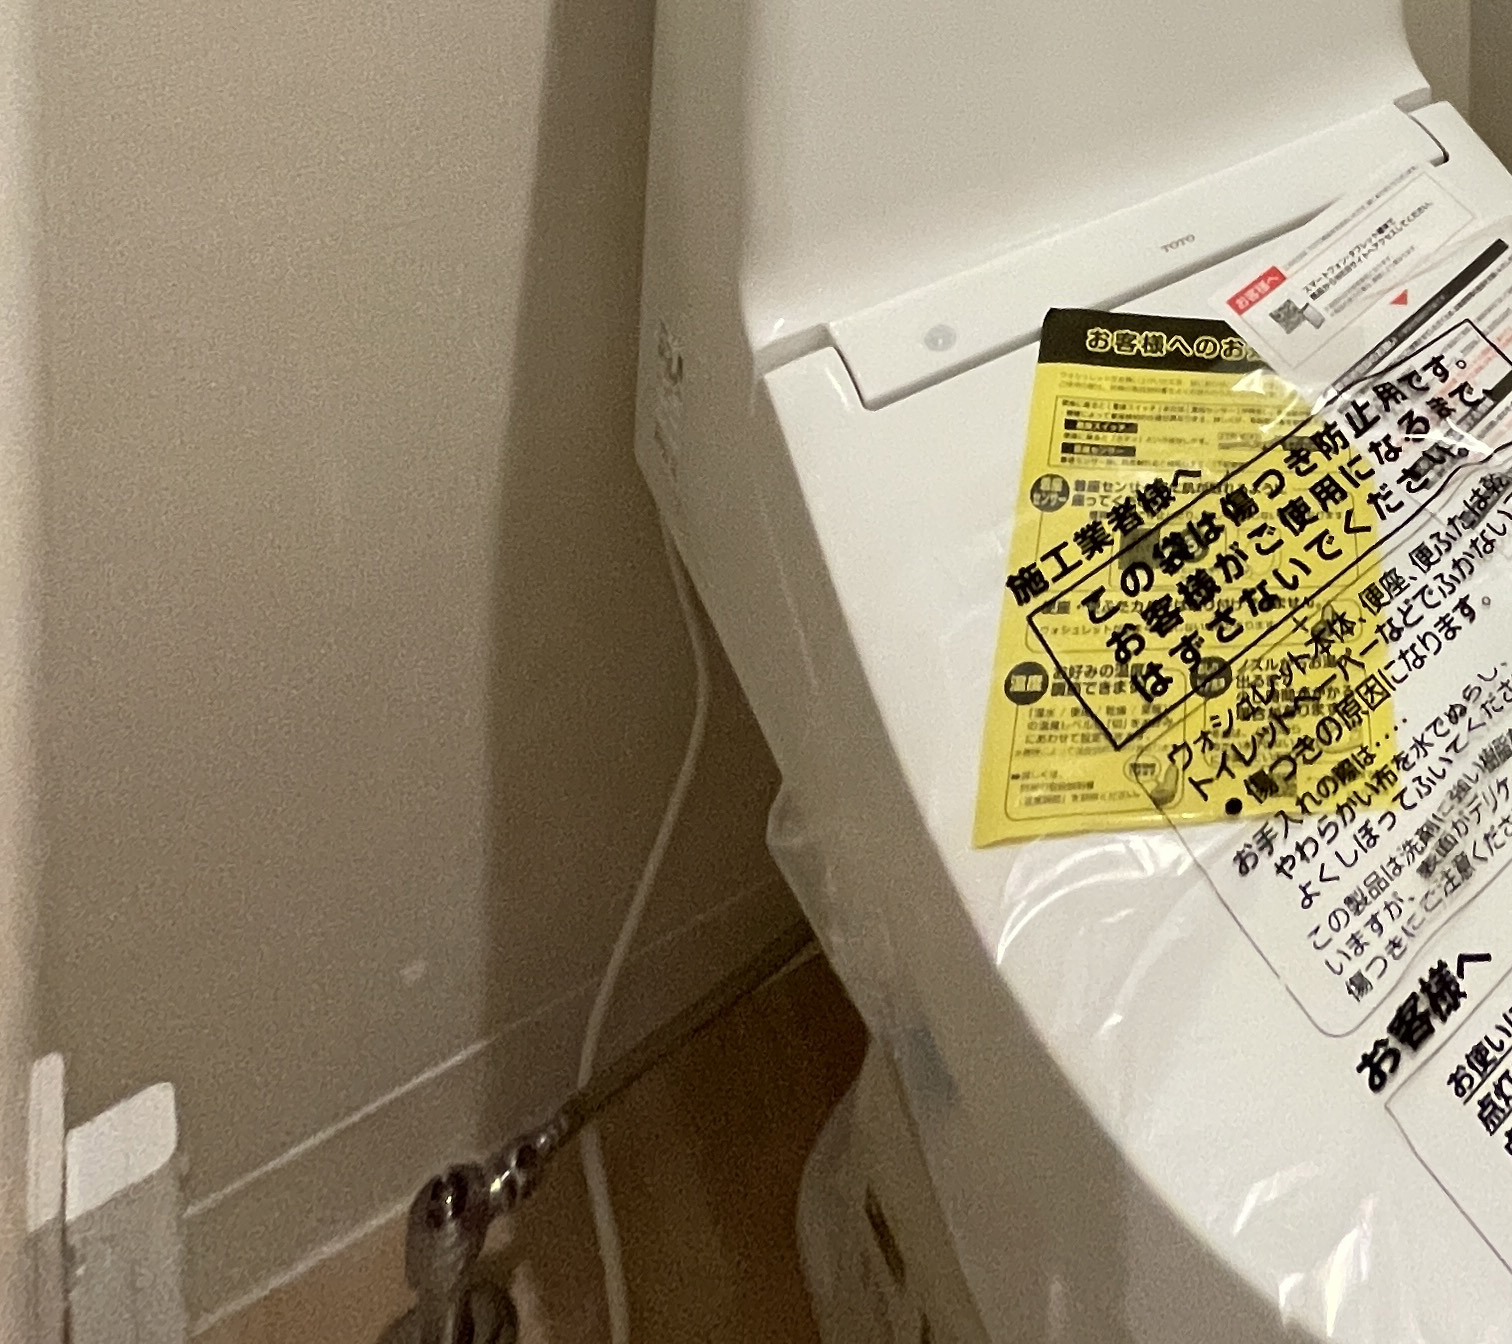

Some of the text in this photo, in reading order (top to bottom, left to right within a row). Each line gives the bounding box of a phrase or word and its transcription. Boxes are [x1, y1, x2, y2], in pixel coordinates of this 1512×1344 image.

[1160, 234, 1195, 253] TOTO
[1086, 327, 1261, 362] お客様へのお
[1006, 470, 1201, 606] 施工業者様へ
[1078, 355, 1466, 624] この袋は傷つき防止用です。
[1127, 431, 1473, 706] はずさないでください。
[1244, 594, 1490, 804] 傷つきの原因になります。
[1356, 953, 1491, 1093] お客様へ
